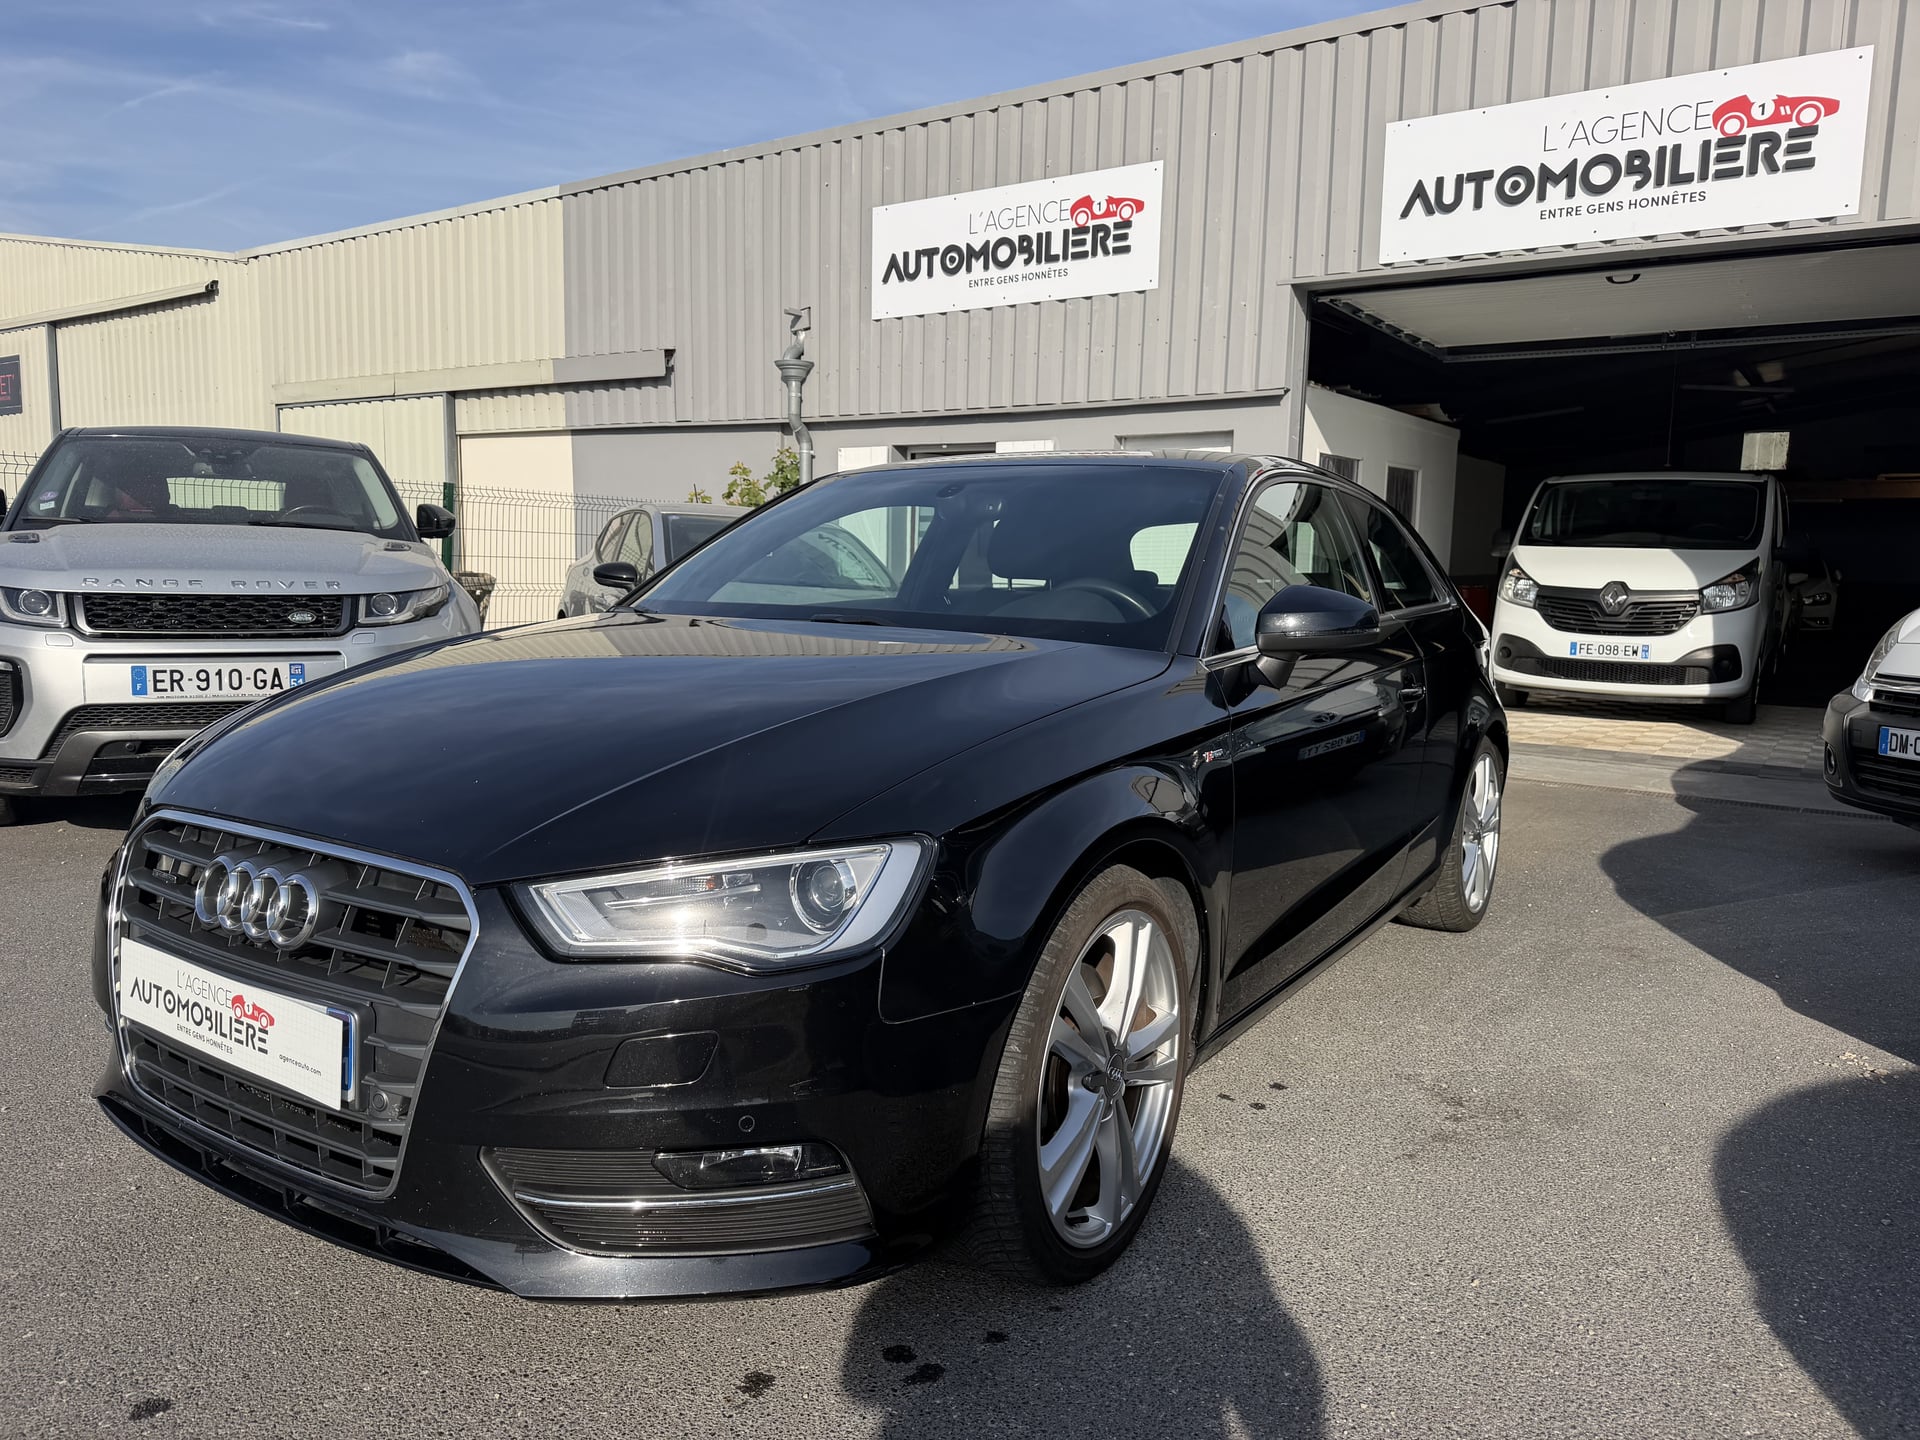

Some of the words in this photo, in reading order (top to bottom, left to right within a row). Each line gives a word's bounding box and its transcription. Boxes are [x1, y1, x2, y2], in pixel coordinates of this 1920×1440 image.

[1543, 100, 1714, 153] L'AGENCE
[969, 199, 1070, 235] L'AGENCE
[1539, 208, 1583, 220] ENTRE
[1586, 201, 1624, 215] GENS
[1628, 190, 1707, 210] HONNÊTES
[968, 276, 994, 288] ENTRE
[996, 274, 1019, 285] GENS
[1021, 267, 1069, 282] HONNÊTES
[1579, 643, 1639, 656] FE-098-EW
[152, 667, 284, 692] ER-910-GA
[177, 970, 232, 1010] L'AGENCE
[176, 1023, 192, 1036] ENTRE
[192, 1029, 205, 1043] GENS
